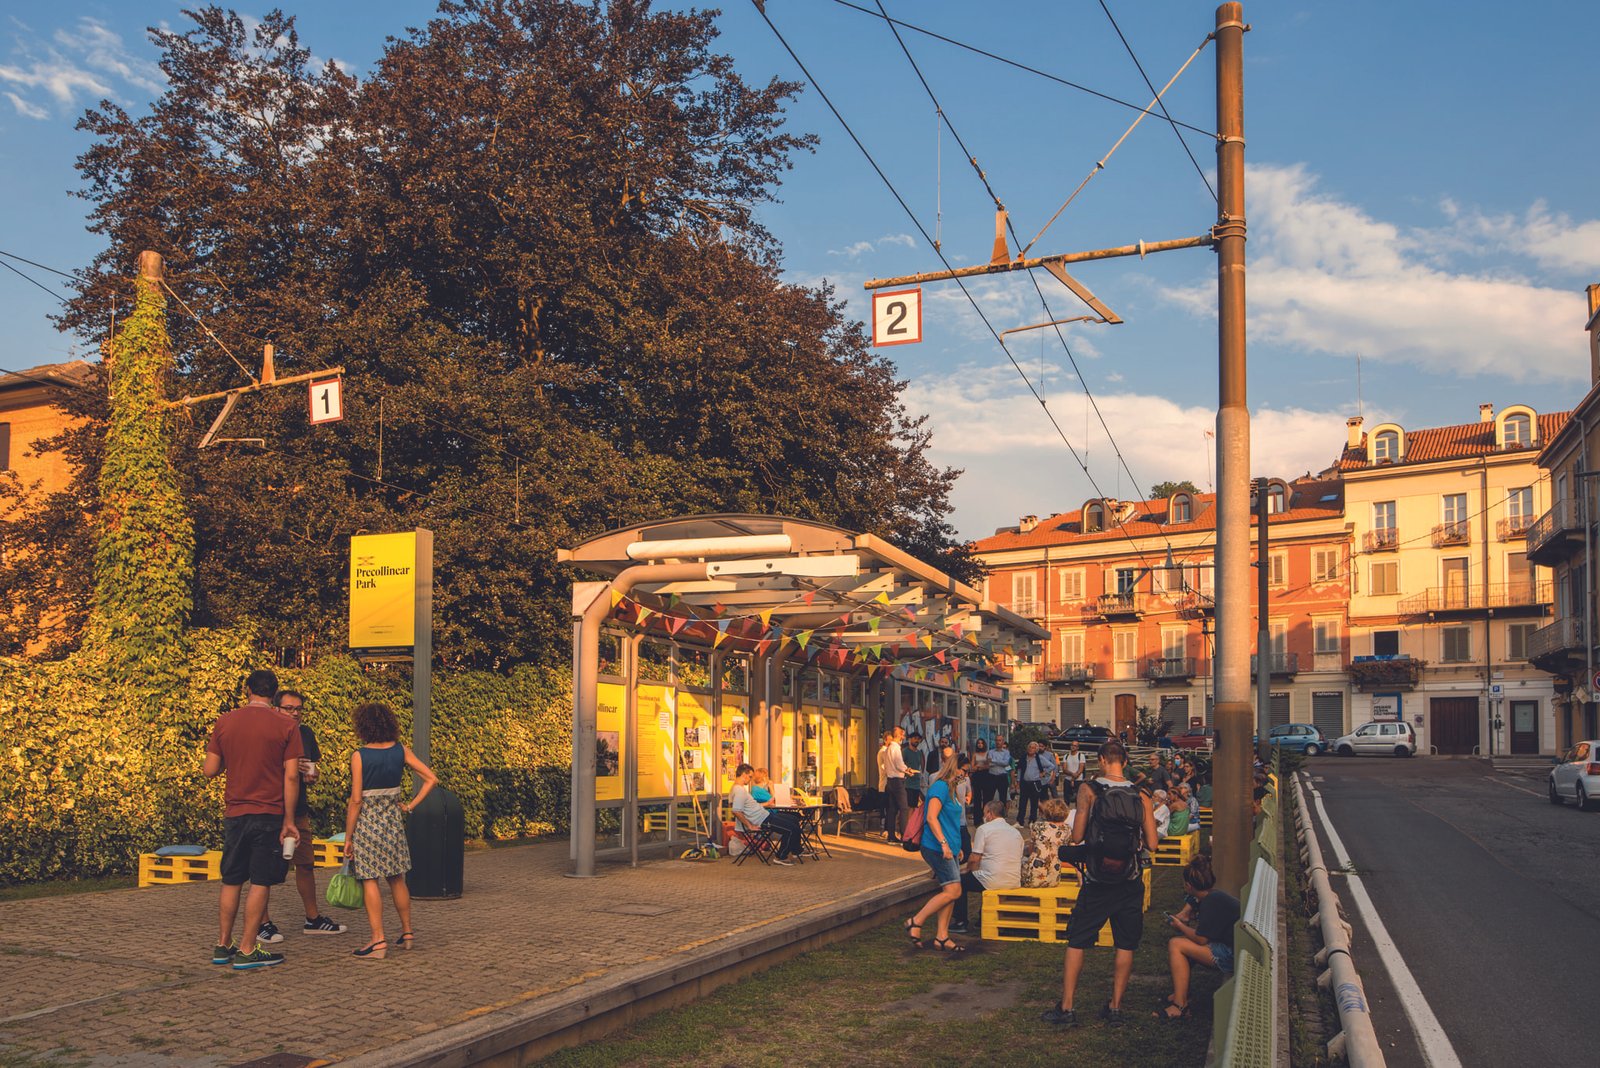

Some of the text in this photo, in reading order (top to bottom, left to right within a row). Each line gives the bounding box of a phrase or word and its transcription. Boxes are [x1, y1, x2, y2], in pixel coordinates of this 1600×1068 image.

[887, 301, 907, 335] 2
[321, 388, 329, 414] 1
[356, 566, 410, 577] Precollinear
[356, 578, 376, 589] Park
